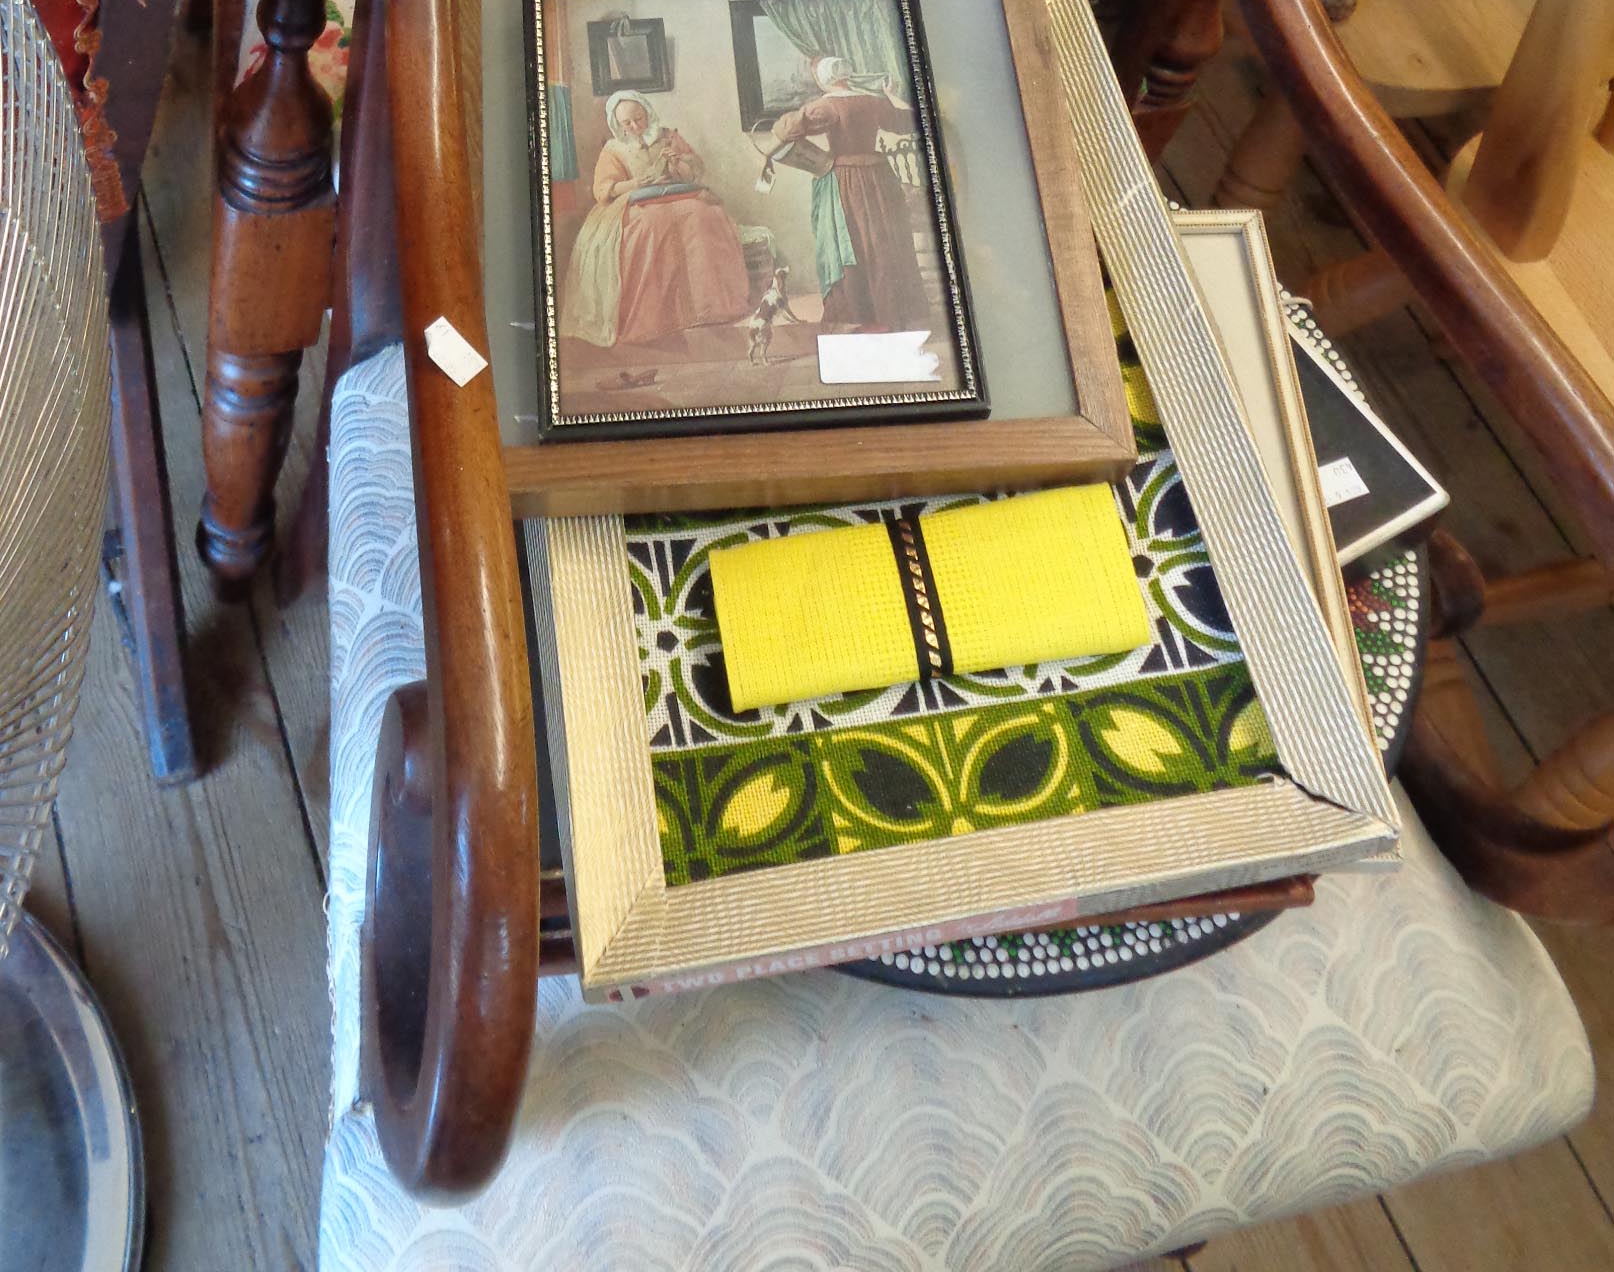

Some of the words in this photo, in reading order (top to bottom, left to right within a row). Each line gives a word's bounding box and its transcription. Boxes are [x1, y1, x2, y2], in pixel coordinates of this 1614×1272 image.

[663, 970, 722, 993] TWO
[735, 953, 820, 979] PLACE
[831, 929, 942, 958] SETTING
